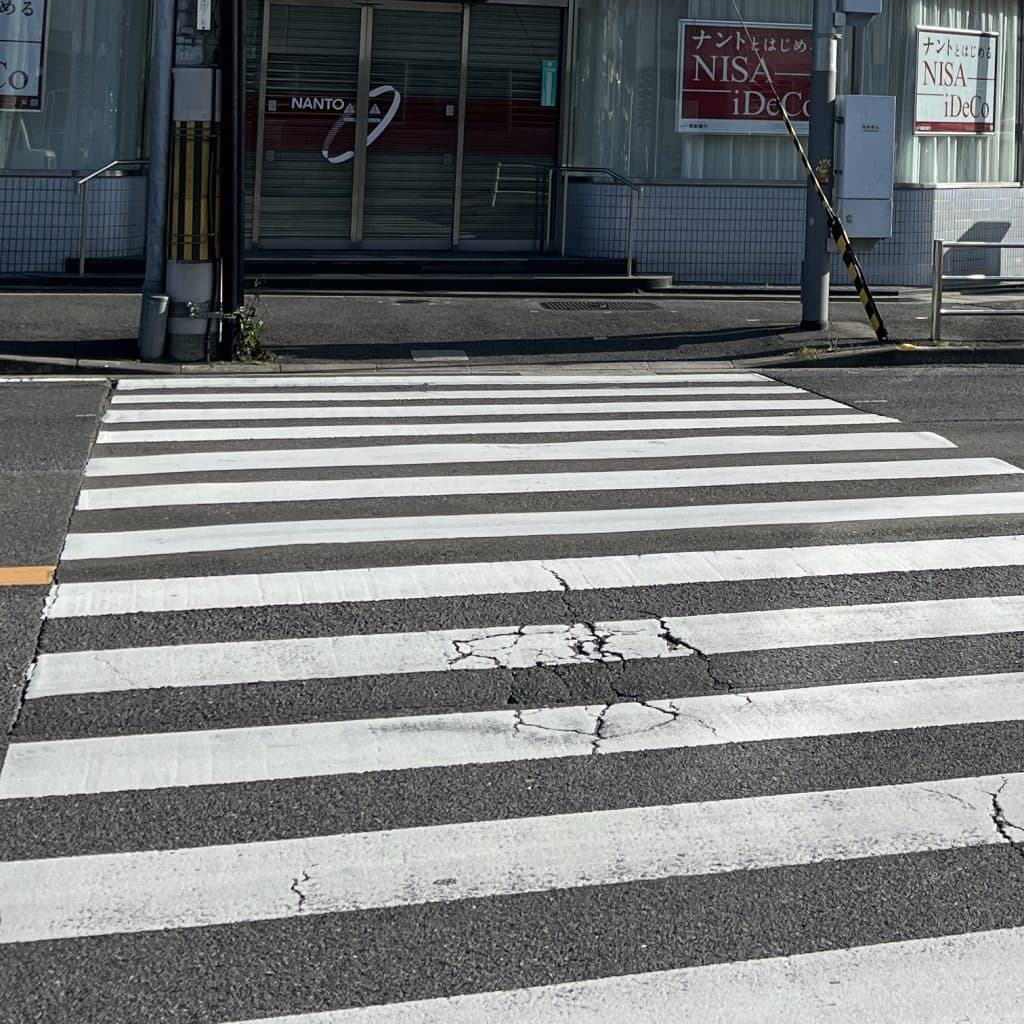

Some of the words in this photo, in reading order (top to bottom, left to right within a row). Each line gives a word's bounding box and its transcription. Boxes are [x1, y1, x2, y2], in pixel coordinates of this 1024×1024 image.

[692, 29, 812, 53] ナントとはじめ
[922, 36, 992, 60] ナントとはじめる
[691, 55, 774, 83] NISA
[922, 60, 967, 87] NISA
[291, 97, 345, 111] NANTO
[944, 93, 990, 119] iDeCo
